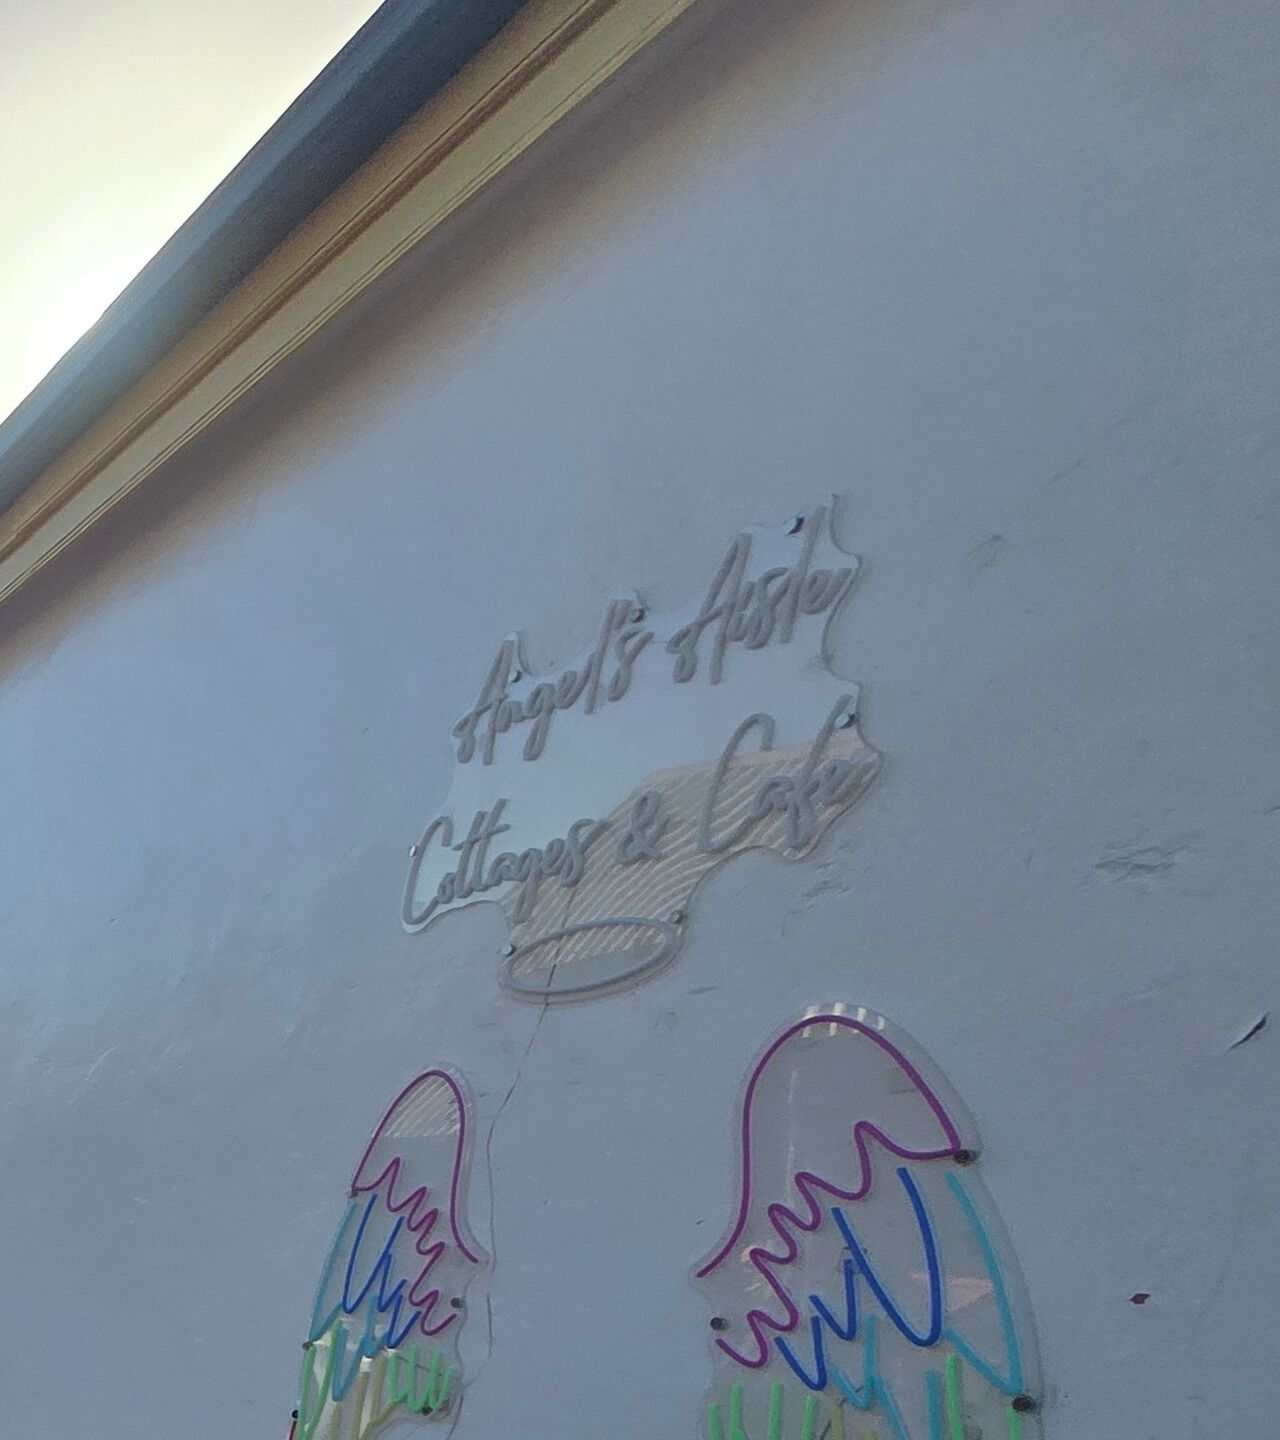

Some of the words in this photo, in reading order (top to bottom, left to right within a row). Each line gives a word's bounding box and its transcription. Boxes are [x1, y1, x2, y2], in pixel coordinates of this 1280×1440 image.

[453, 598, 654, 766] Angel's
[403, 799, 612, 924] Cottages
[615, 791, 666, 866] &
[697, 694, 877, 853] Cafe
